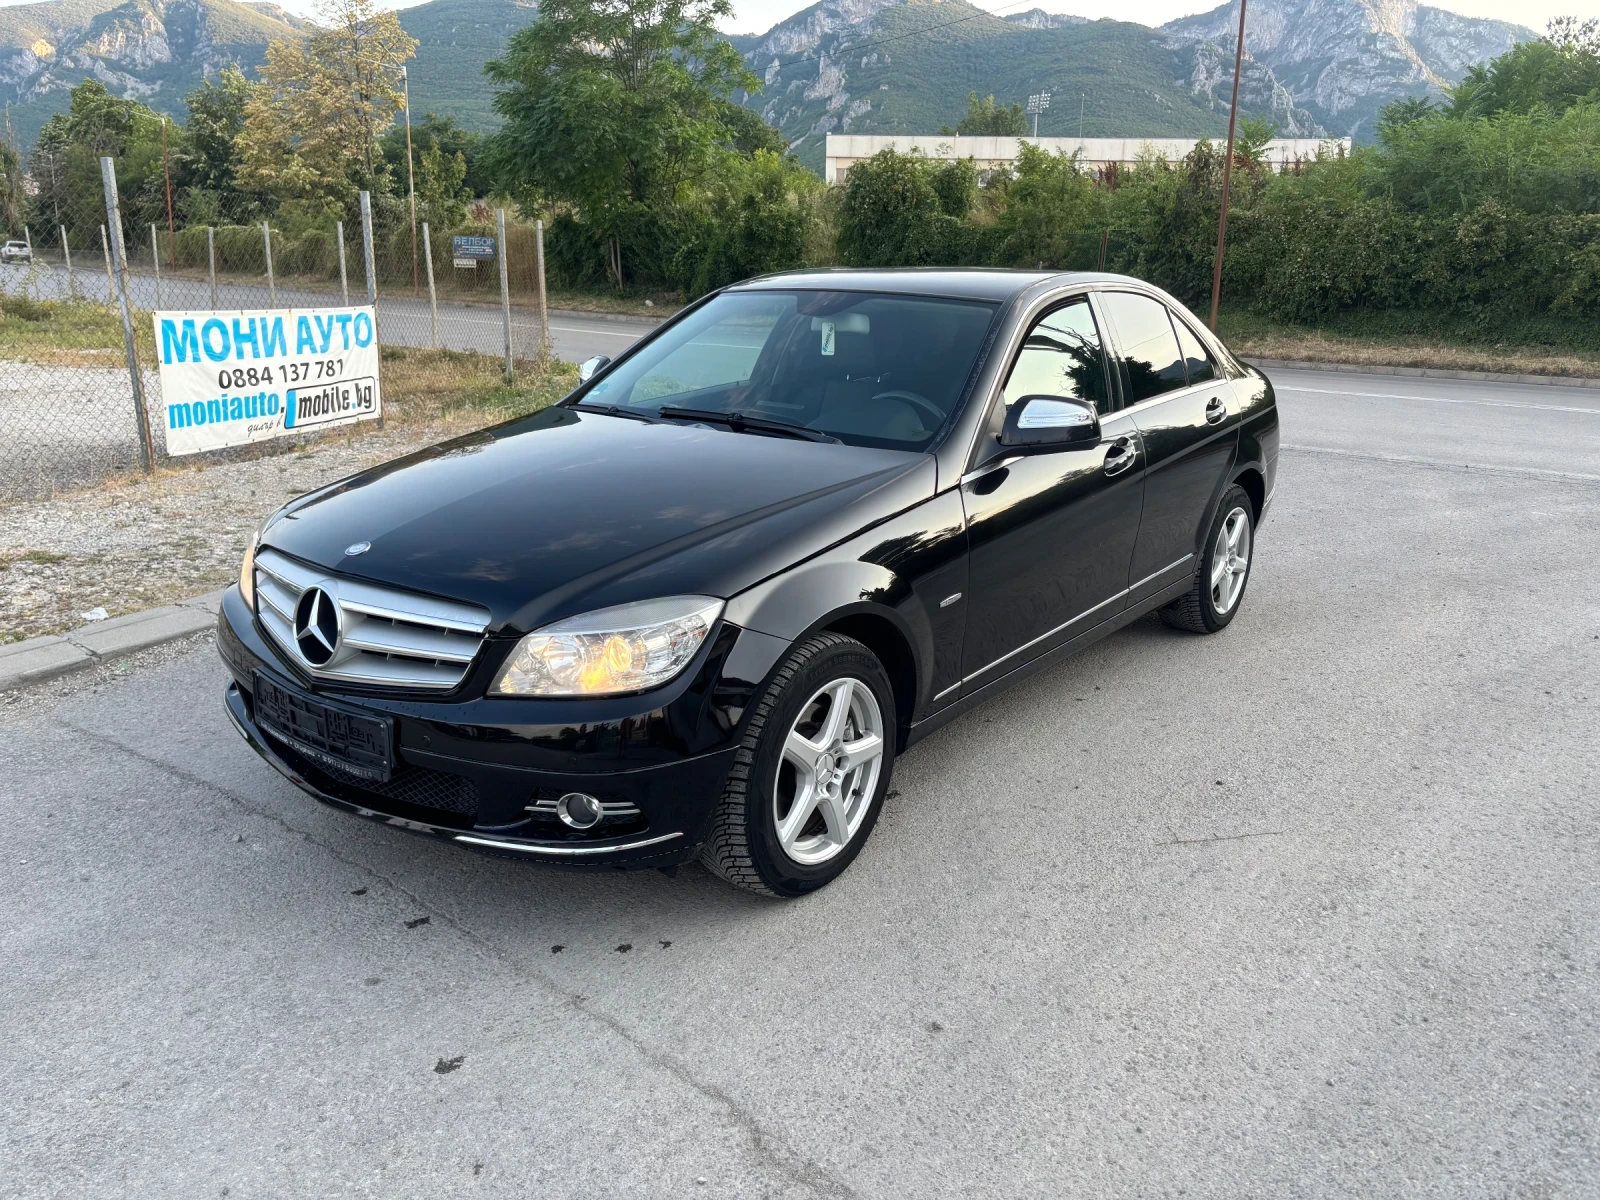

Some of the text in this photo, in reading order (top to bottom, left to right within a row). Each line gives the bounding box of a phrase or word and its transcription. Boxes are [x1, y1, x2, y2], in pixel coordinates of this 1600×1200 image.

[161, 312, 373, 365] МОНИ АУТО
[218, 358, 344, 389] 0884 137 781
